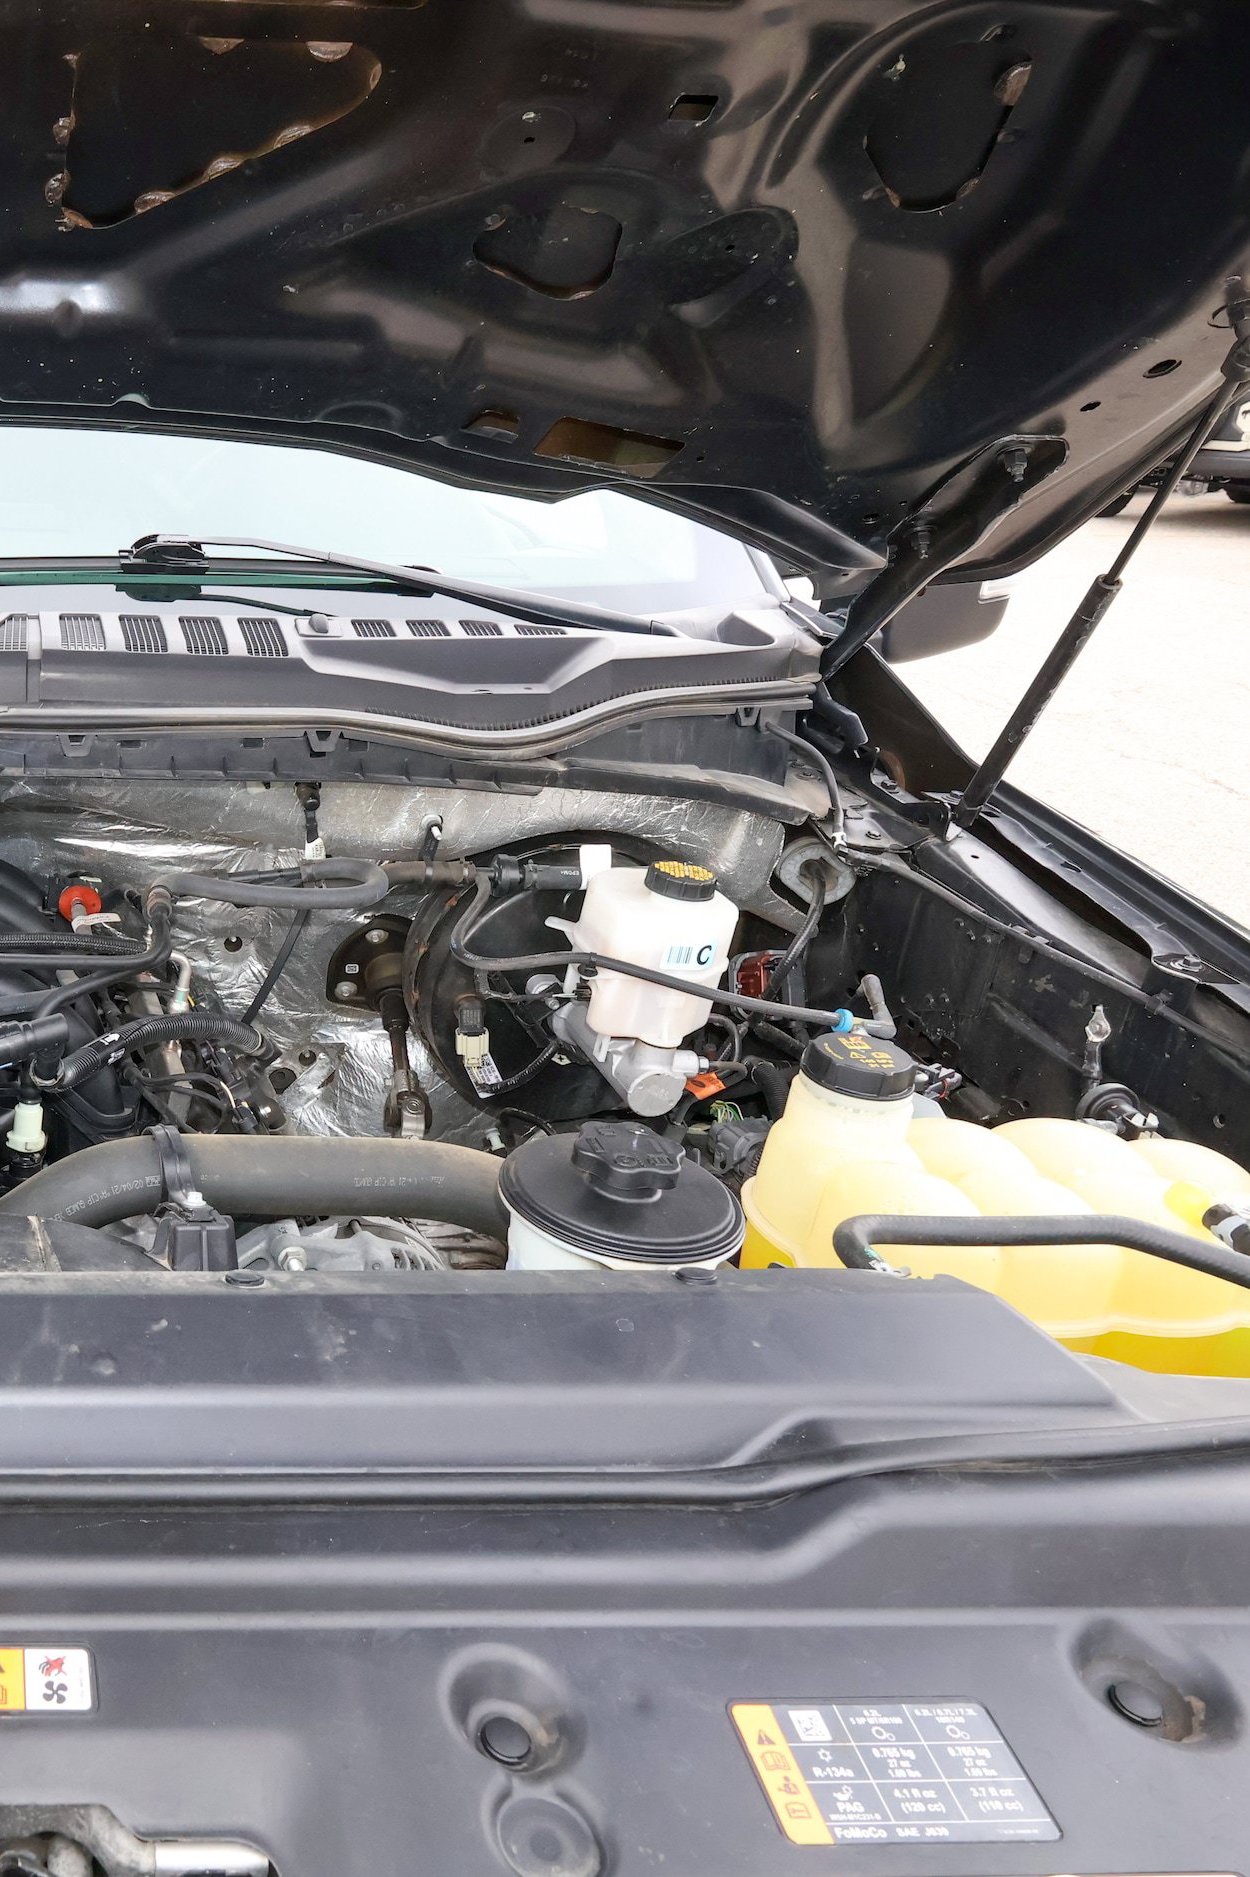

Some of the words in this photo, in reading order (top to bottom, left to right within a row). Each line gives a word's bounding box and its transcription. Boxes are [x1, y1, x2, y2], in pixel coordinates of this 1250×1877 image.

[696, 944, 712, 965] C
[899, 1747, 916, 1760] kg
[974, 1746, 992, 1759] kg
[887, 1759, 898, 1768] 27
[962, 1758, 973, 1766] 27
[812, 1766, 854, 1778] R-134a
[906, 1769, 922, 1777] lbs
[982, 1768, 998, 1776] lbs
[894, 1788, 910, 1798] 4.1
[910, 1788, 921, 1798] fl
[922, 1790, 938, 1798] oz
[970, 1787, 986, 1797] 3.7
[988, 1787, 999, 1797] fl
[1000, 1788, 1015, 1797] oz
[836, 1801, 865, 1813] PAG
[901, 1802, 926, 1814] (120
[927, 1801, 946, 1814] cc)
[1005, 1800, 1024, 1812] cc)
[834, 1827, 888, 1839] FoMoCo
[896, 1827, 920, 1837] SAE
